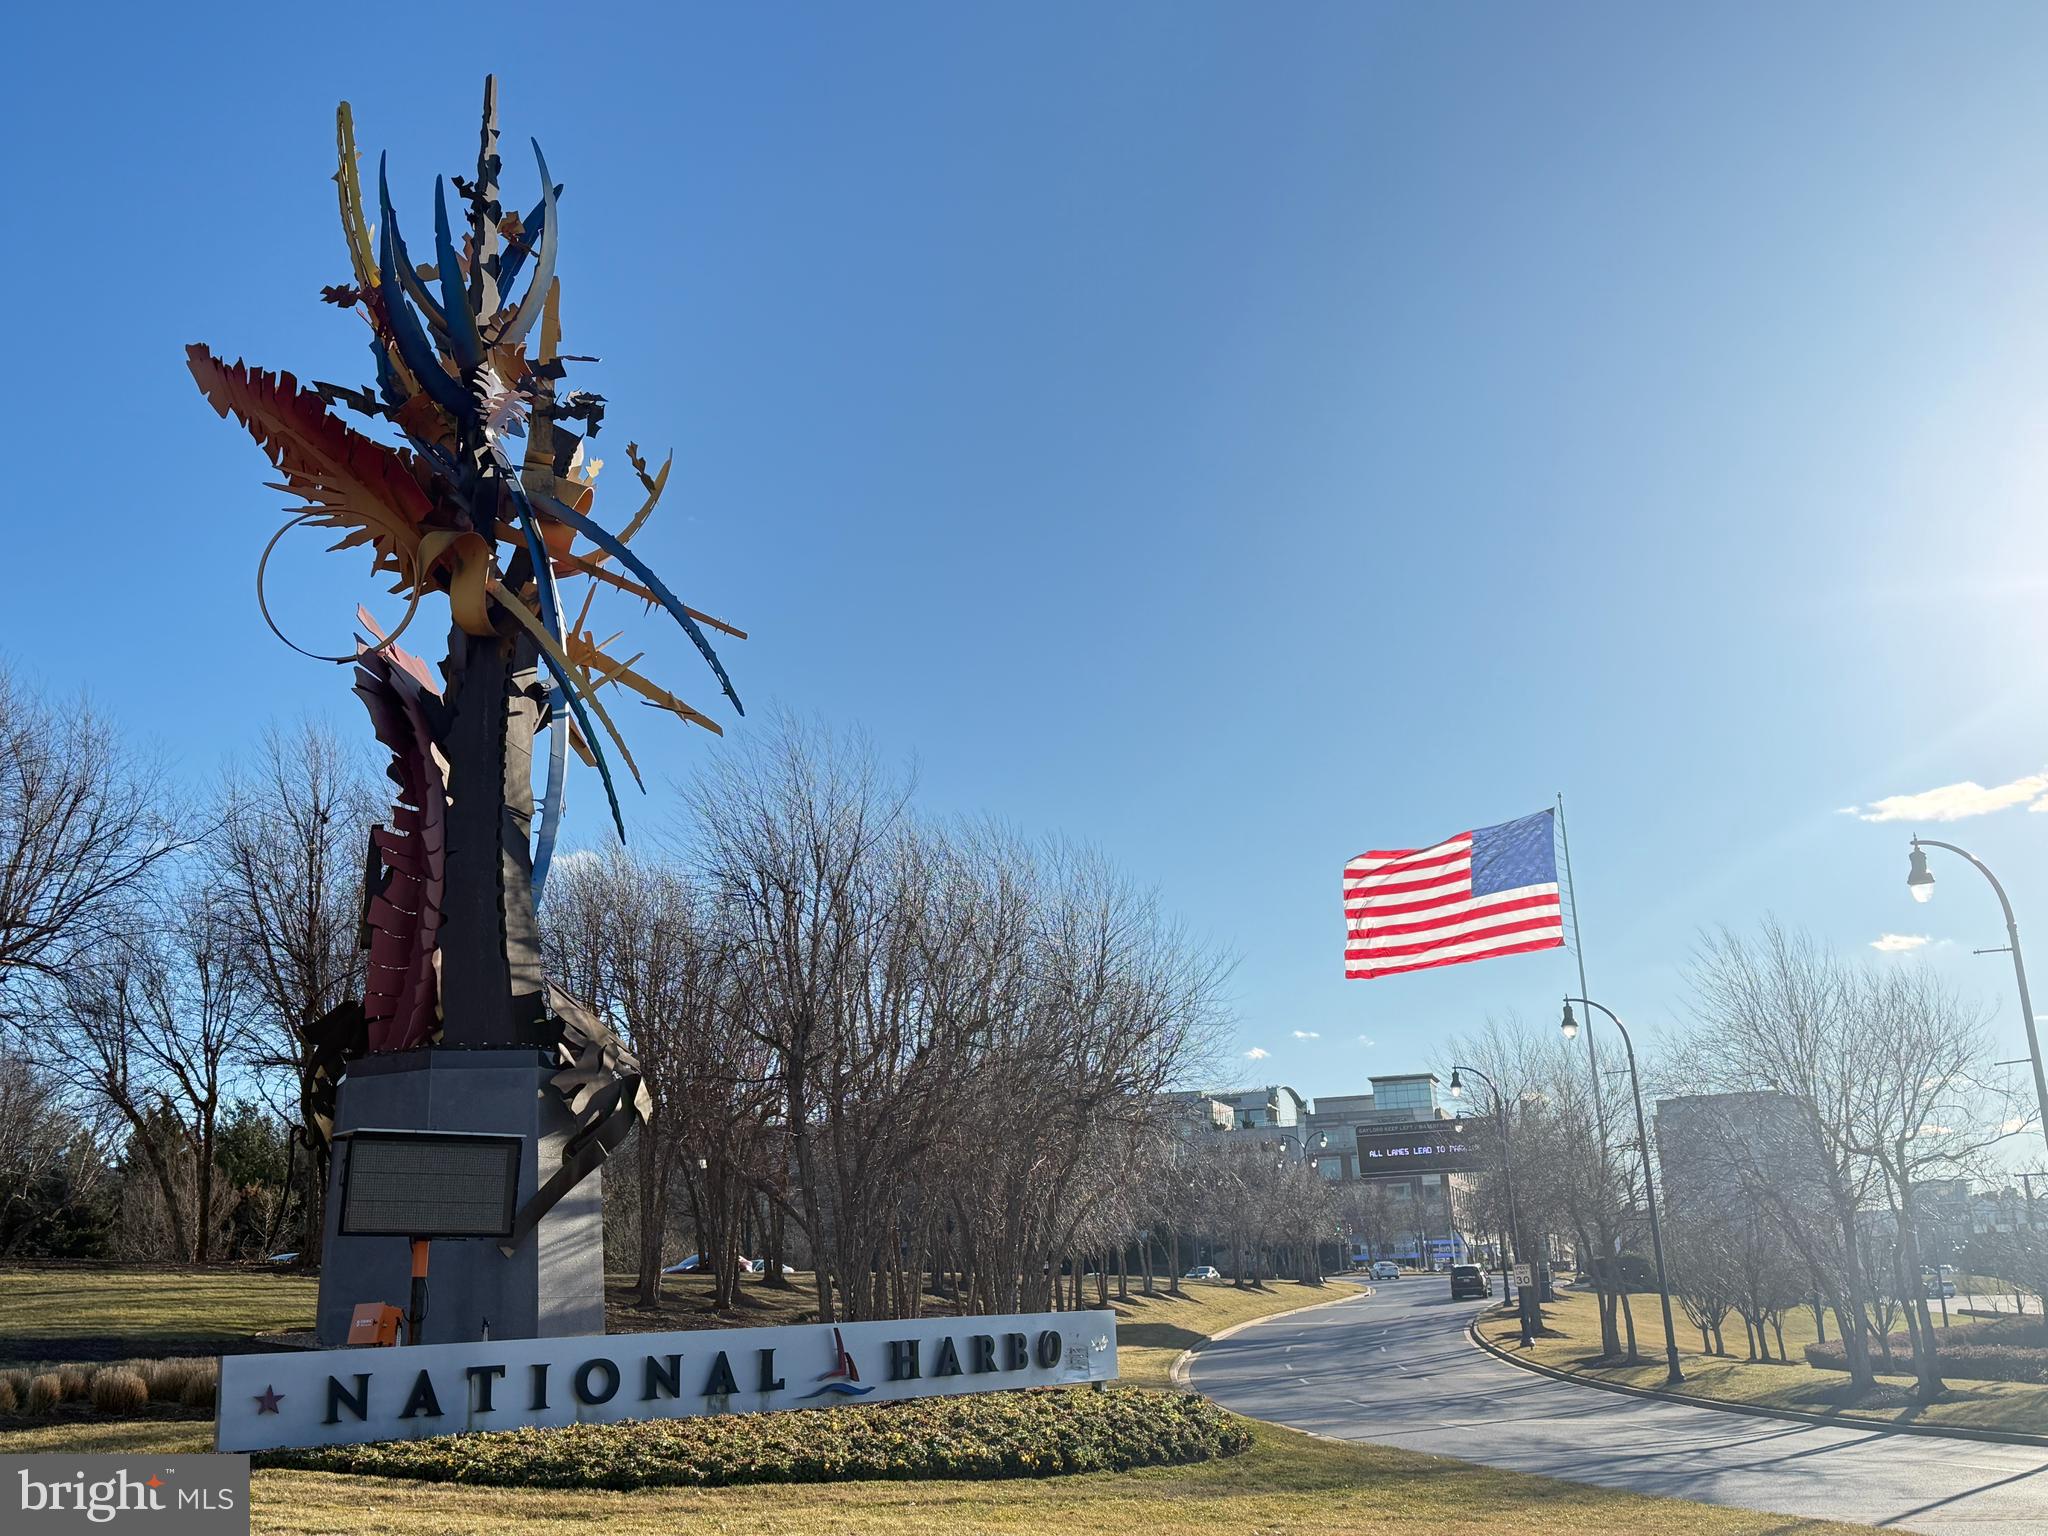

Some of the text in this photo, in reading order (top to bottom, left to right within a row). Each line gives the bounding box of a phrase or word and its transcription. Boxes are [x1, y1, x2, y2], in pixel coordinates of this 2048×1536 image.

[1369, 1149, 1383, 1158] ALL
[1386, 1147, 1410, 1157] LANES
[1413, 1146, 1433, 1155] LEAD
[1436, 1145, 1446, 1153] TO
[1516, 1275, 1530, 1285] 30
[321, 1330, 1063, 1425] NATIONAL HARBO
